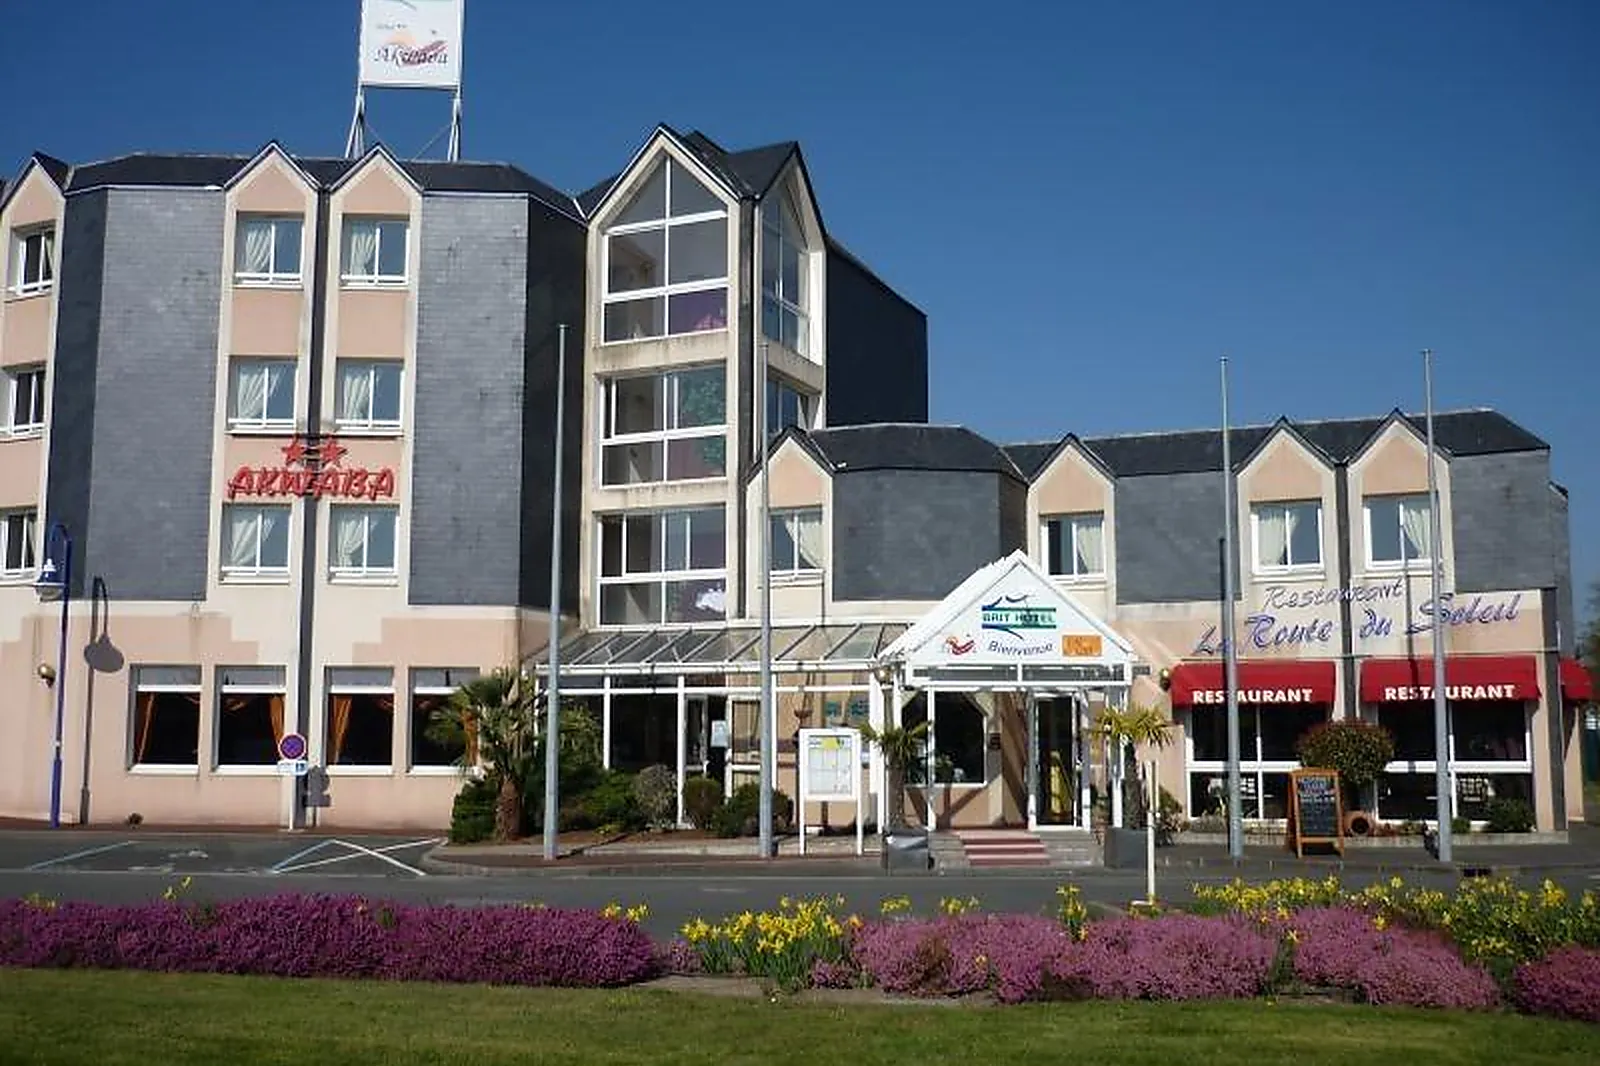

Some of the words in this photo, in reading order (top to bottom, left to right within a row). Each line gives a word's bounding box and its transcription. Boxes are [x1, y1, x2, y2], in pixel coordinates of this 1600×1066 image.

[227, 465, 394, 501] AKWABA
[982, 611, 1010, 622] BRIT
[1015, 611, 1055, 623] HOTEL
[1192, 688, 1313, 704] RESAURANT
[1384, 684, 1515, 701] RESTURANT
